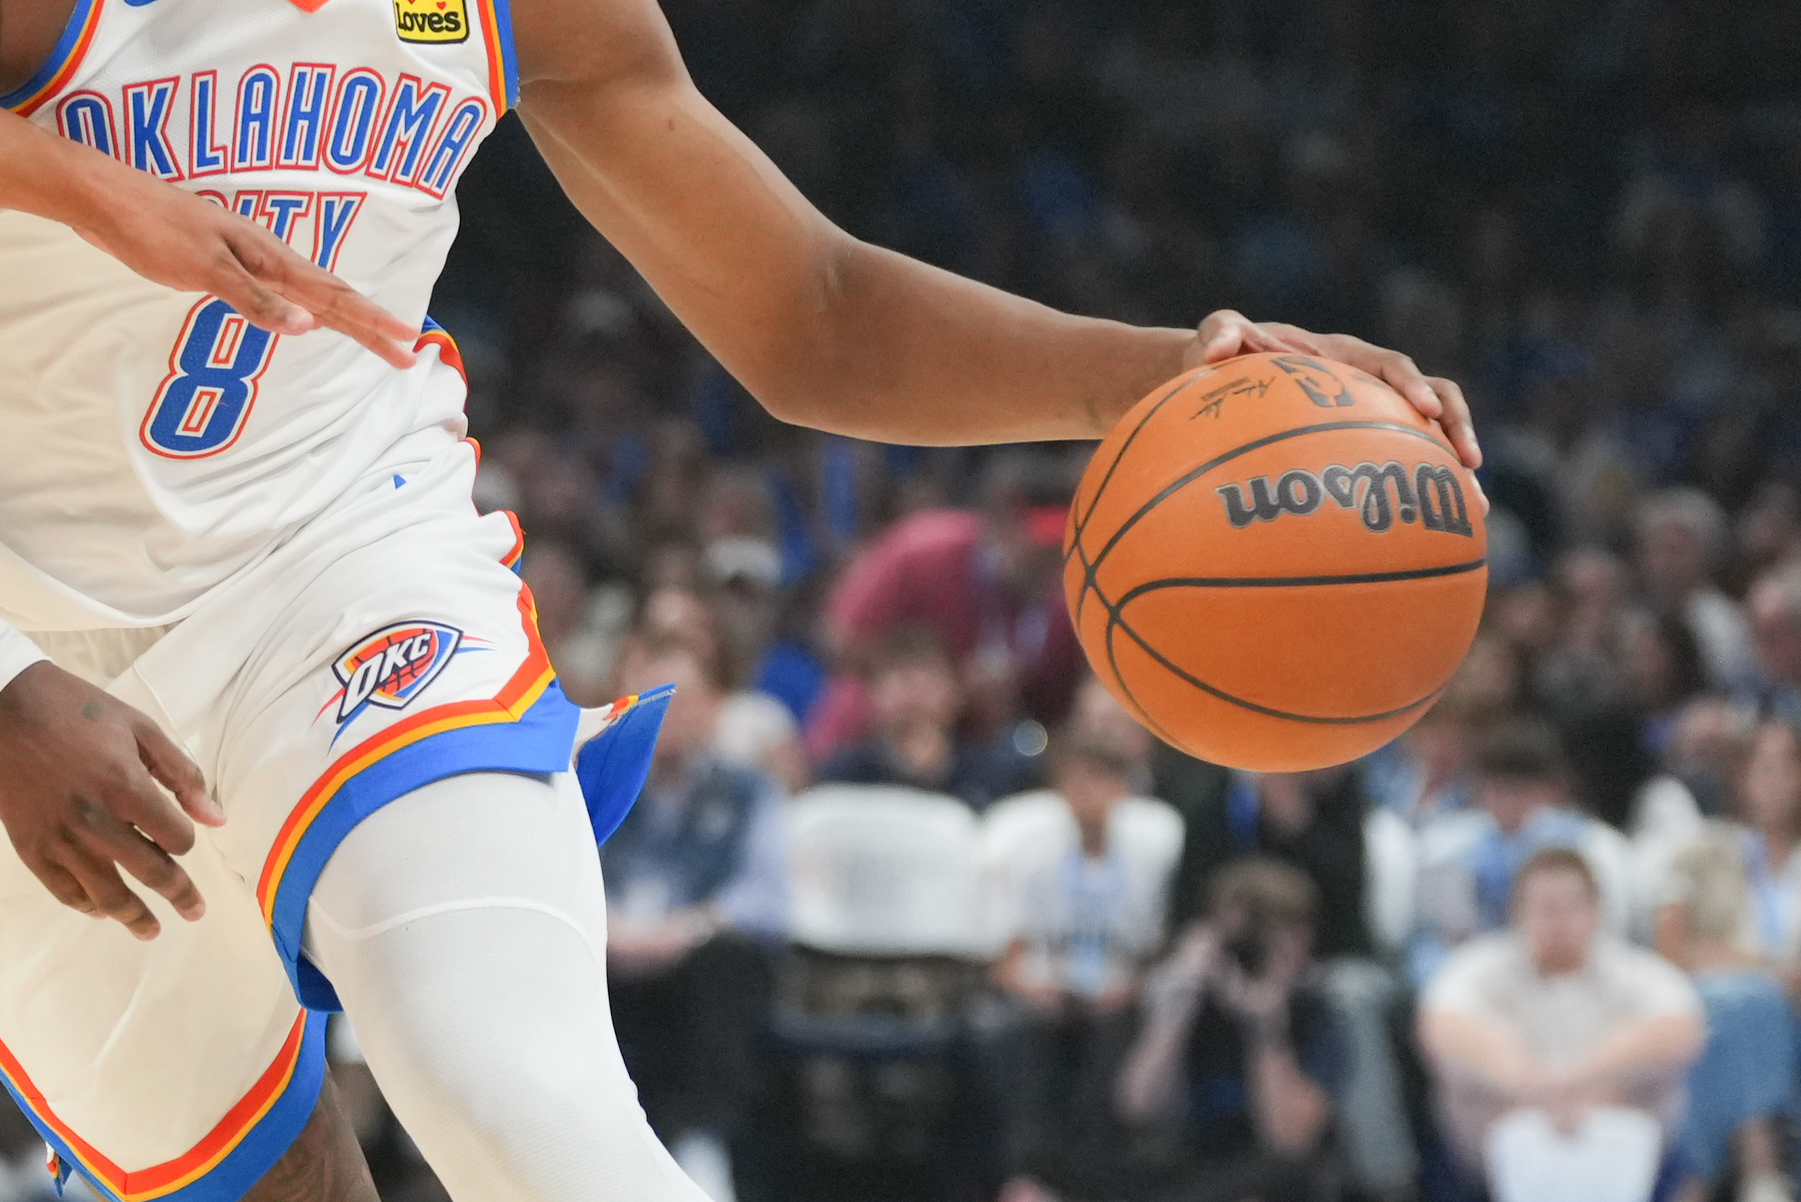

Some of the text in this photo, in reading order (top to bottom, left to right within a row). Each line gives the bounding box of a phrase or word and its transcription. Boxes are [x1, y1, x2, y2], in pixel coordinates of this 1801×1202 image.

[56, 62, 488, 200] OKLAHOMA
[139, 292, 280, 460] 8
[1214, 459, 1473, 539] Wilson
[336, 631, 432, 724] OKC
